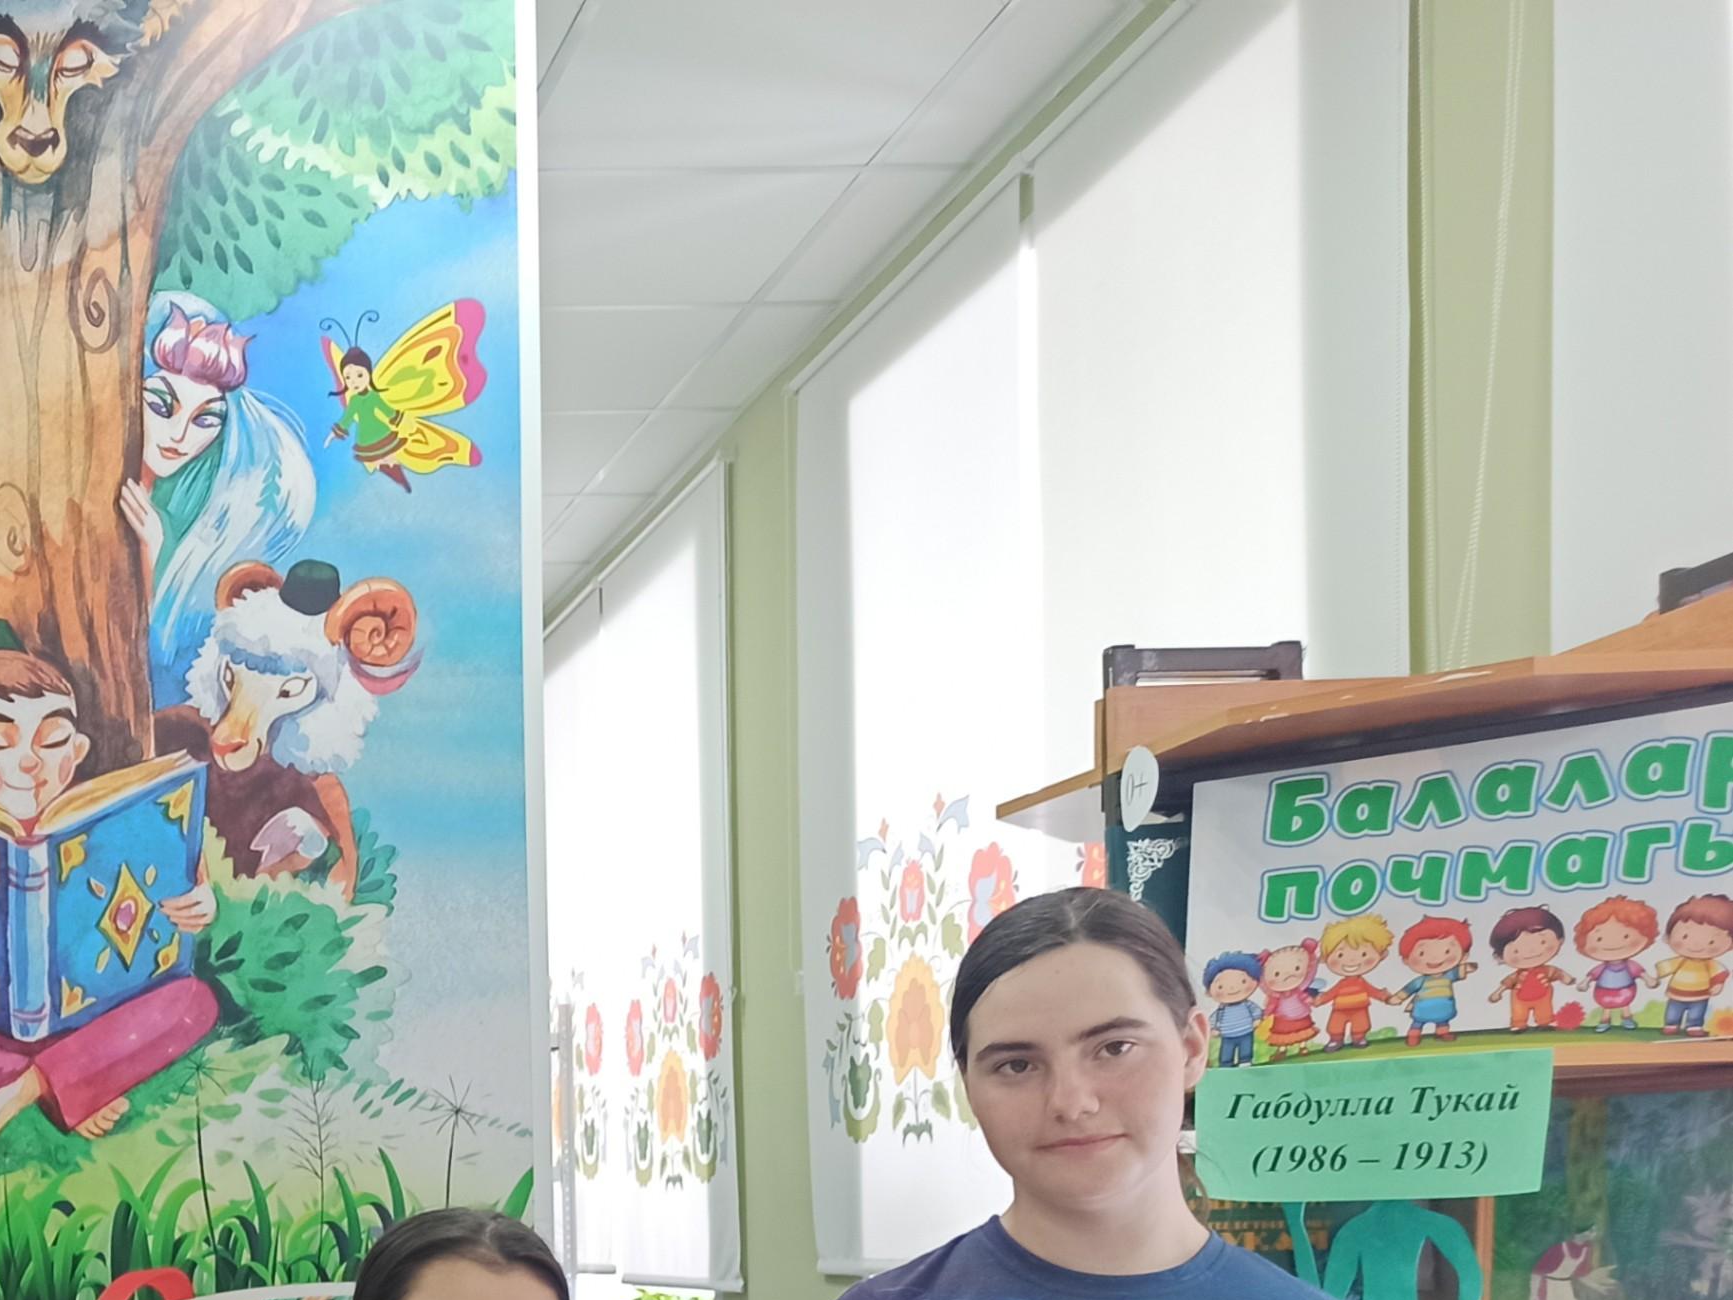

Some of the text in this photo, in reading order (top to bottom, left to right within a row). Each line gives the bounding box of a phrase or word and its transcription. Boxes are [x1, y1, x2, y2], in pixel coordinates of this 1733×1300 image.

[1126, 773, 1148, 804] 0+
[1225, 1083, 1521, 1126] Габдулла Тукай
[1251, 1142, 1348, 1177] (1986
[1392, 1140, 1489, 1174] 1913)
